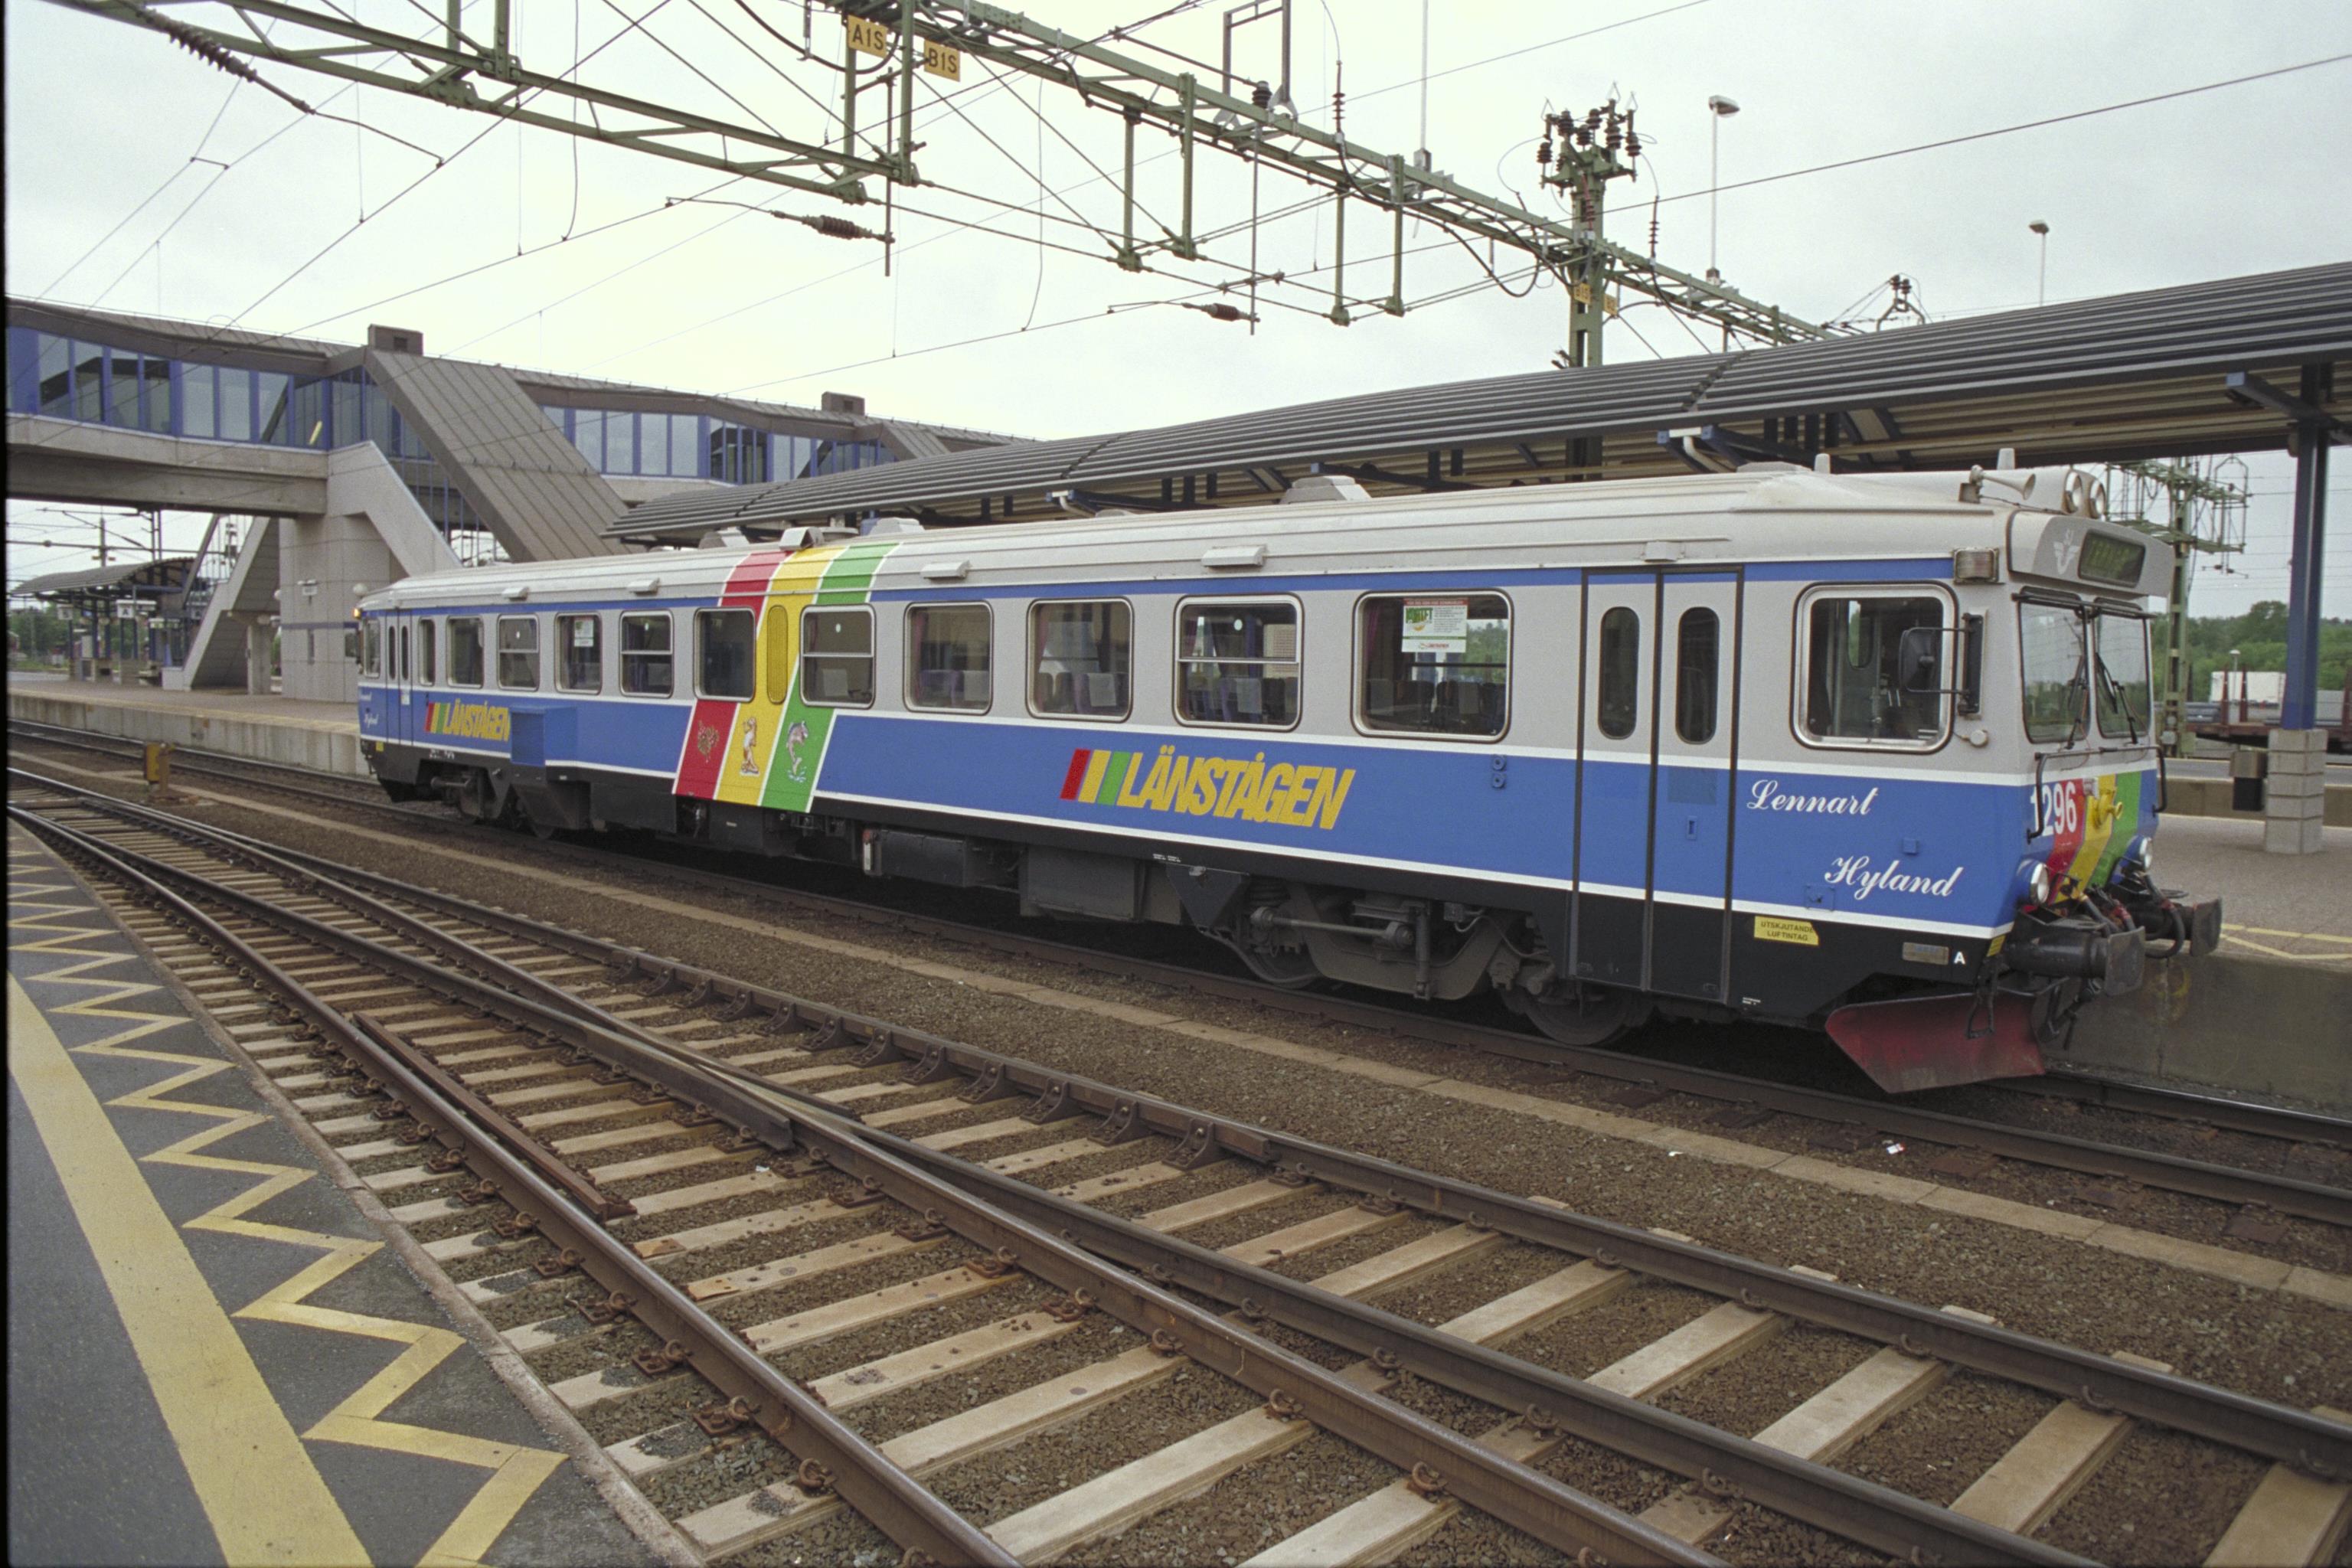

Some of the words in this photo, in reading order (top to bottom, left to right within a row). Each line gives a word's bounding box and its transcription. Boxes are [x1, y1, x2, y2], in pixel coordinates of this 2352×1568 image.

[853, 24, 884, 51] A1S
[929, 48, 957, 74] B1S
[444, 698, 511, 741] LÄNSTÅGEN
[1116, 744, 1356, 829] LÄNSTÅGEN
[1746, 779, 1879, 816] Lennart
[2030, 781, 2077, 837] 1296
[1824, 855, 1965, 900] Hyland
[1760, 921, 1813, 933] UTSKJUTANDE
[1767, 930, 1808, 941] LUFTINTAG
[1953, 951, 1966, 965] A
